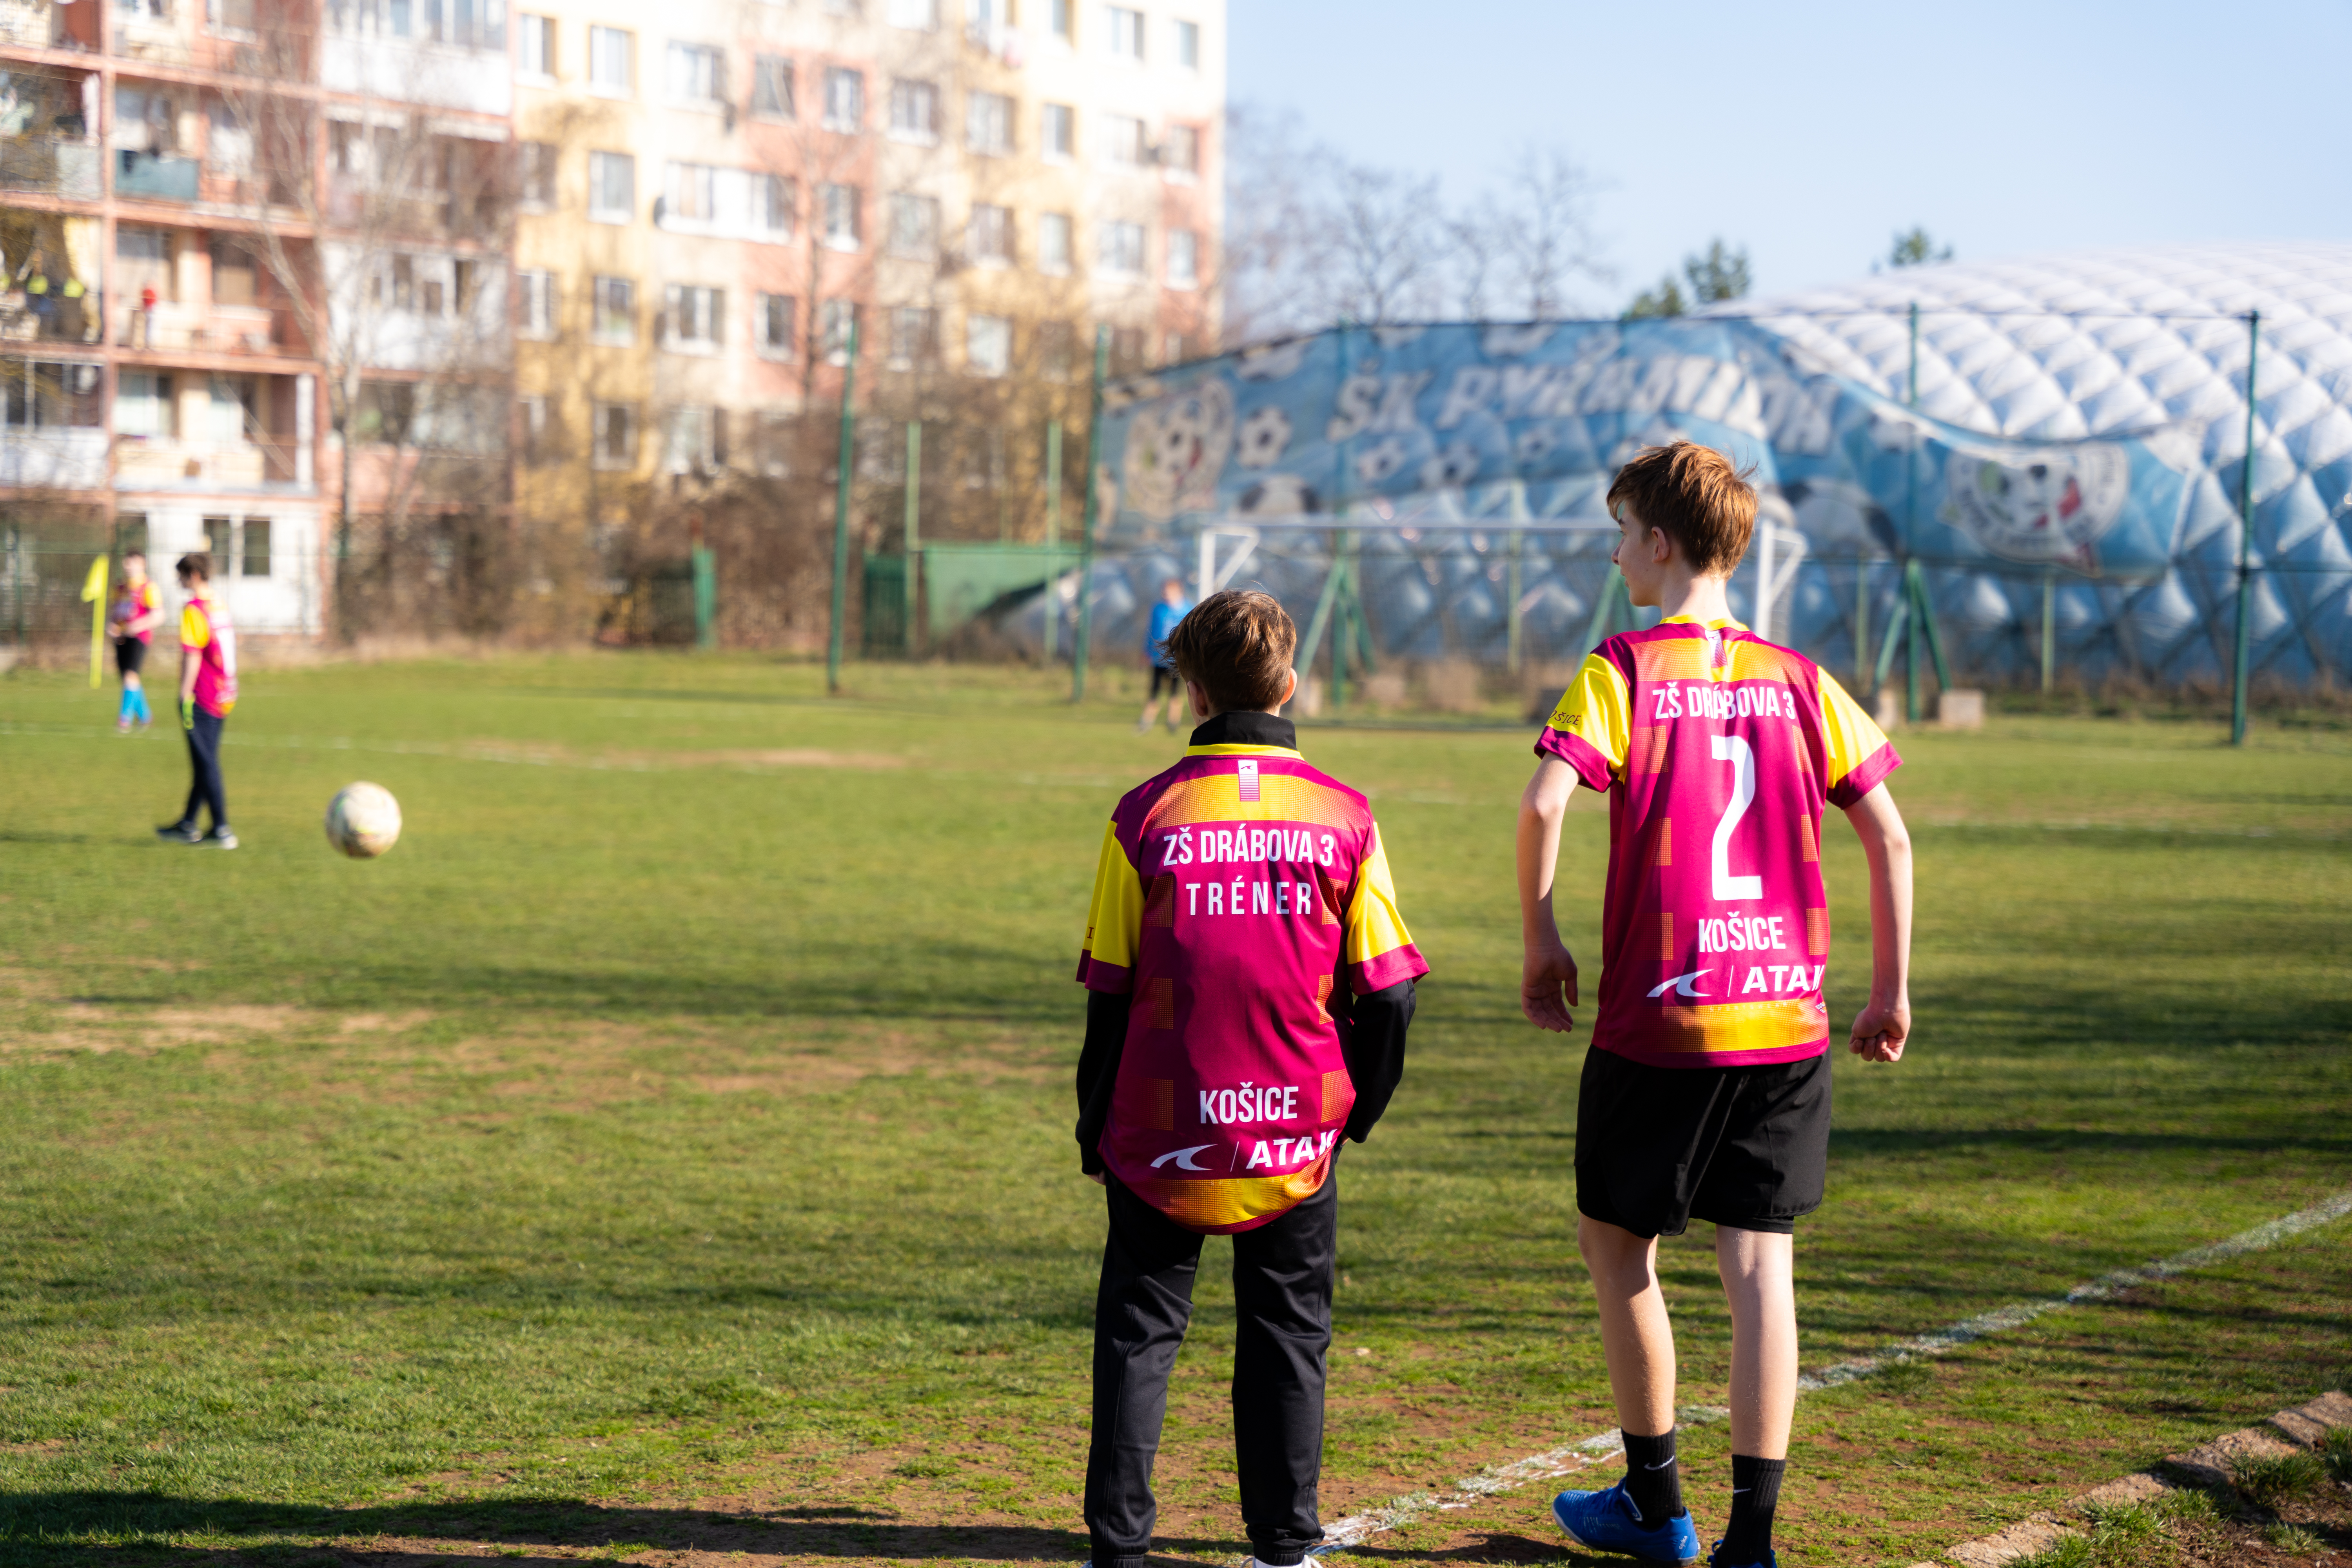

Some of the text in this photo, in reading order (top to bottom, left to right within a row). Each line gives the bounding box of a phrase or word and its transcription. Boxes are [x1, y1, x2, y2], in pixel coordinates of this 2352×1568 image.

[1652, 682, 1795, 720] ZŠ DRÁBOVA 3
[1711, 734, 1762, 901] 2
[1163, 823, 1334, 867] ZŠ DRÁBOVA 3
[1185, 875, 1312, 916] TRÉNER
[1699, 911, 1786, 953] KOŠICE
[1741, 964, 1825, 994] ATAK
[1200, 1082, 1299, 1124] KOŠICE
[1245, 1129, 1338, 1169] ATAK
